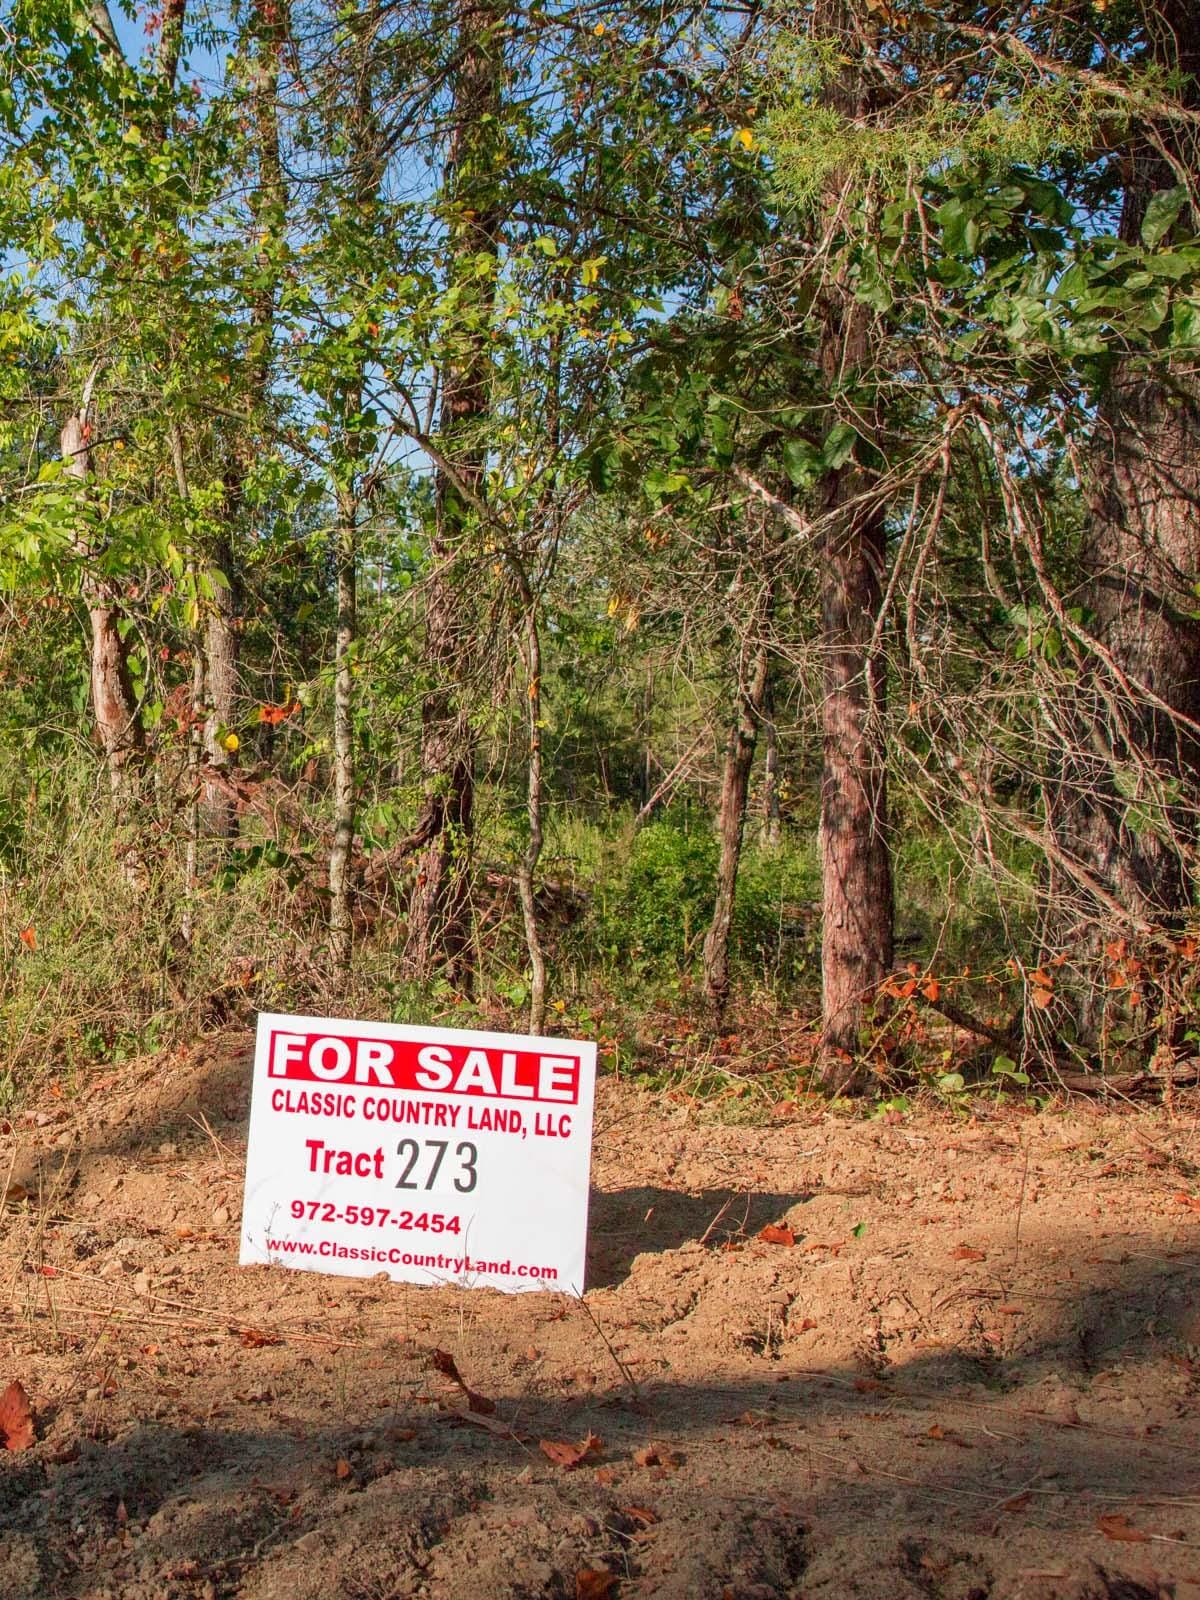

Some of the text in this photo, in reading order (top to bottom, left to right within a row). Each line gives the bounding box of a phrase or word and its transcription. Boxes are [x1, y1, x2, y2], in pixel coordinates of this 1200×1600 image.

[272, 1033, 577, 1101] FOR SALE
[271, 1088, 572, 1140] CLASSIC COUNTRY LAND, LLC
[305, 1138, 479, 1193] Tract 273
[290, 1200, 461, 1235] 972-597-2454
[265, 1237, 558, 1280] www.ClassicCountryLand.com
